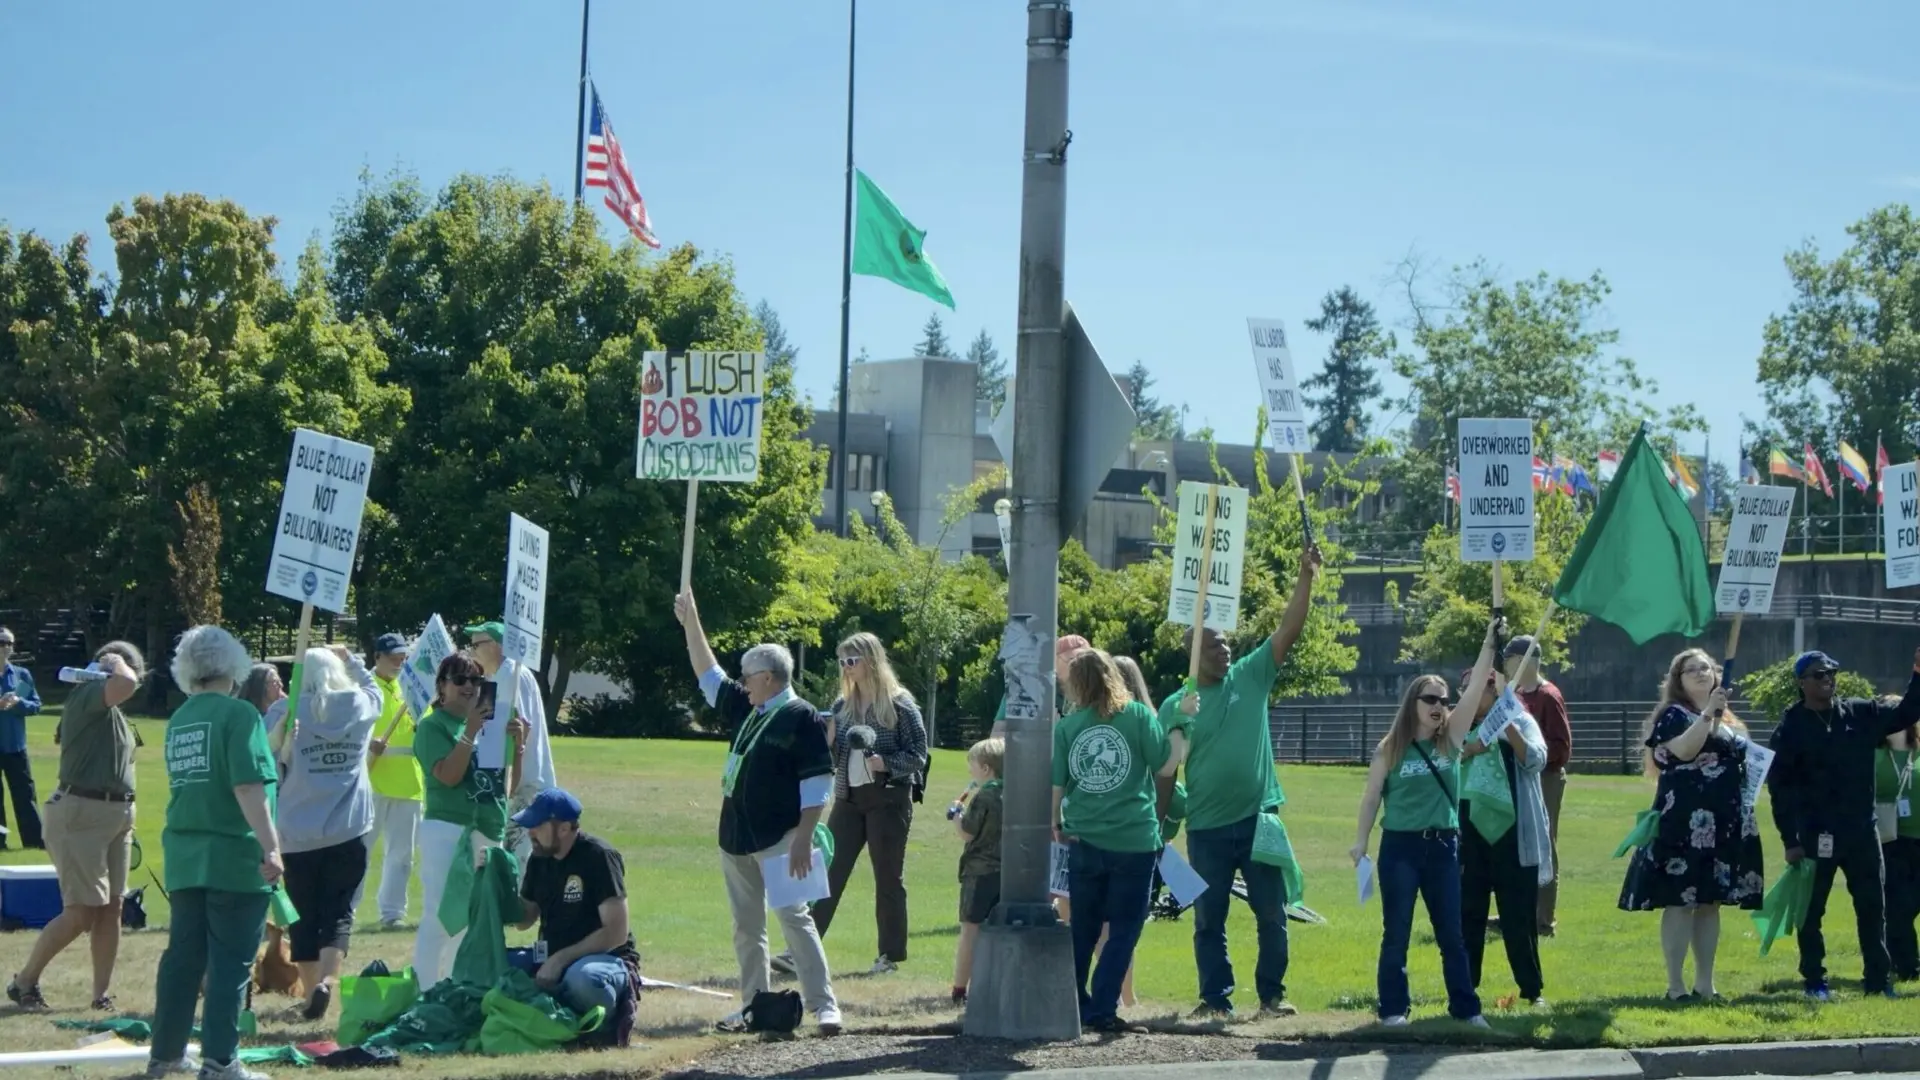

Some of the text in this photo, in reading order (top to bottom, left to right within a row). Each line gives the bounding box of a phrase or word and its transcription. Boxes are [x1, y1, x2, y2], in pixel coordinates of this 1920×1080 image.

[1253, 327, 1287, 348] ALL LABOR
[665, 351, 755, 398] FLUSH
[1267, 357, 1284, 380] HAS
[1268, 388, 1297, 412] DIGNITY
[642, 396, 761, 438] BOB NOT
[1462, 436, 1530, 455] OVERWORKED
[296, 445, 366, 485] BLUE COLLAR
[642, 437, 757, 481] CUSTODIANS
[1484, 464, 1509, 487] AND
[312, 484, 338, 515] NOT
[1469, 497, 1525, 516] UNDERPAID
[1738, 497, 1790, 517] BLUE COLLAR
[283, 512, 353, 553] BILLIONAIRES
[519, 528, 540, 559] LIVING
[1749, 523, 1768, 544] NOT
[1727, 549, 1778, 569] BILLIONAIRES
[516, 560, 540, 592] WAGES
[1209, 560, 1230, 586] ALL
[512, 591, 538, 625] FOR ALL
[175, 730, 205, 746] PROUD
[174, 743, 203, 758] UNION
